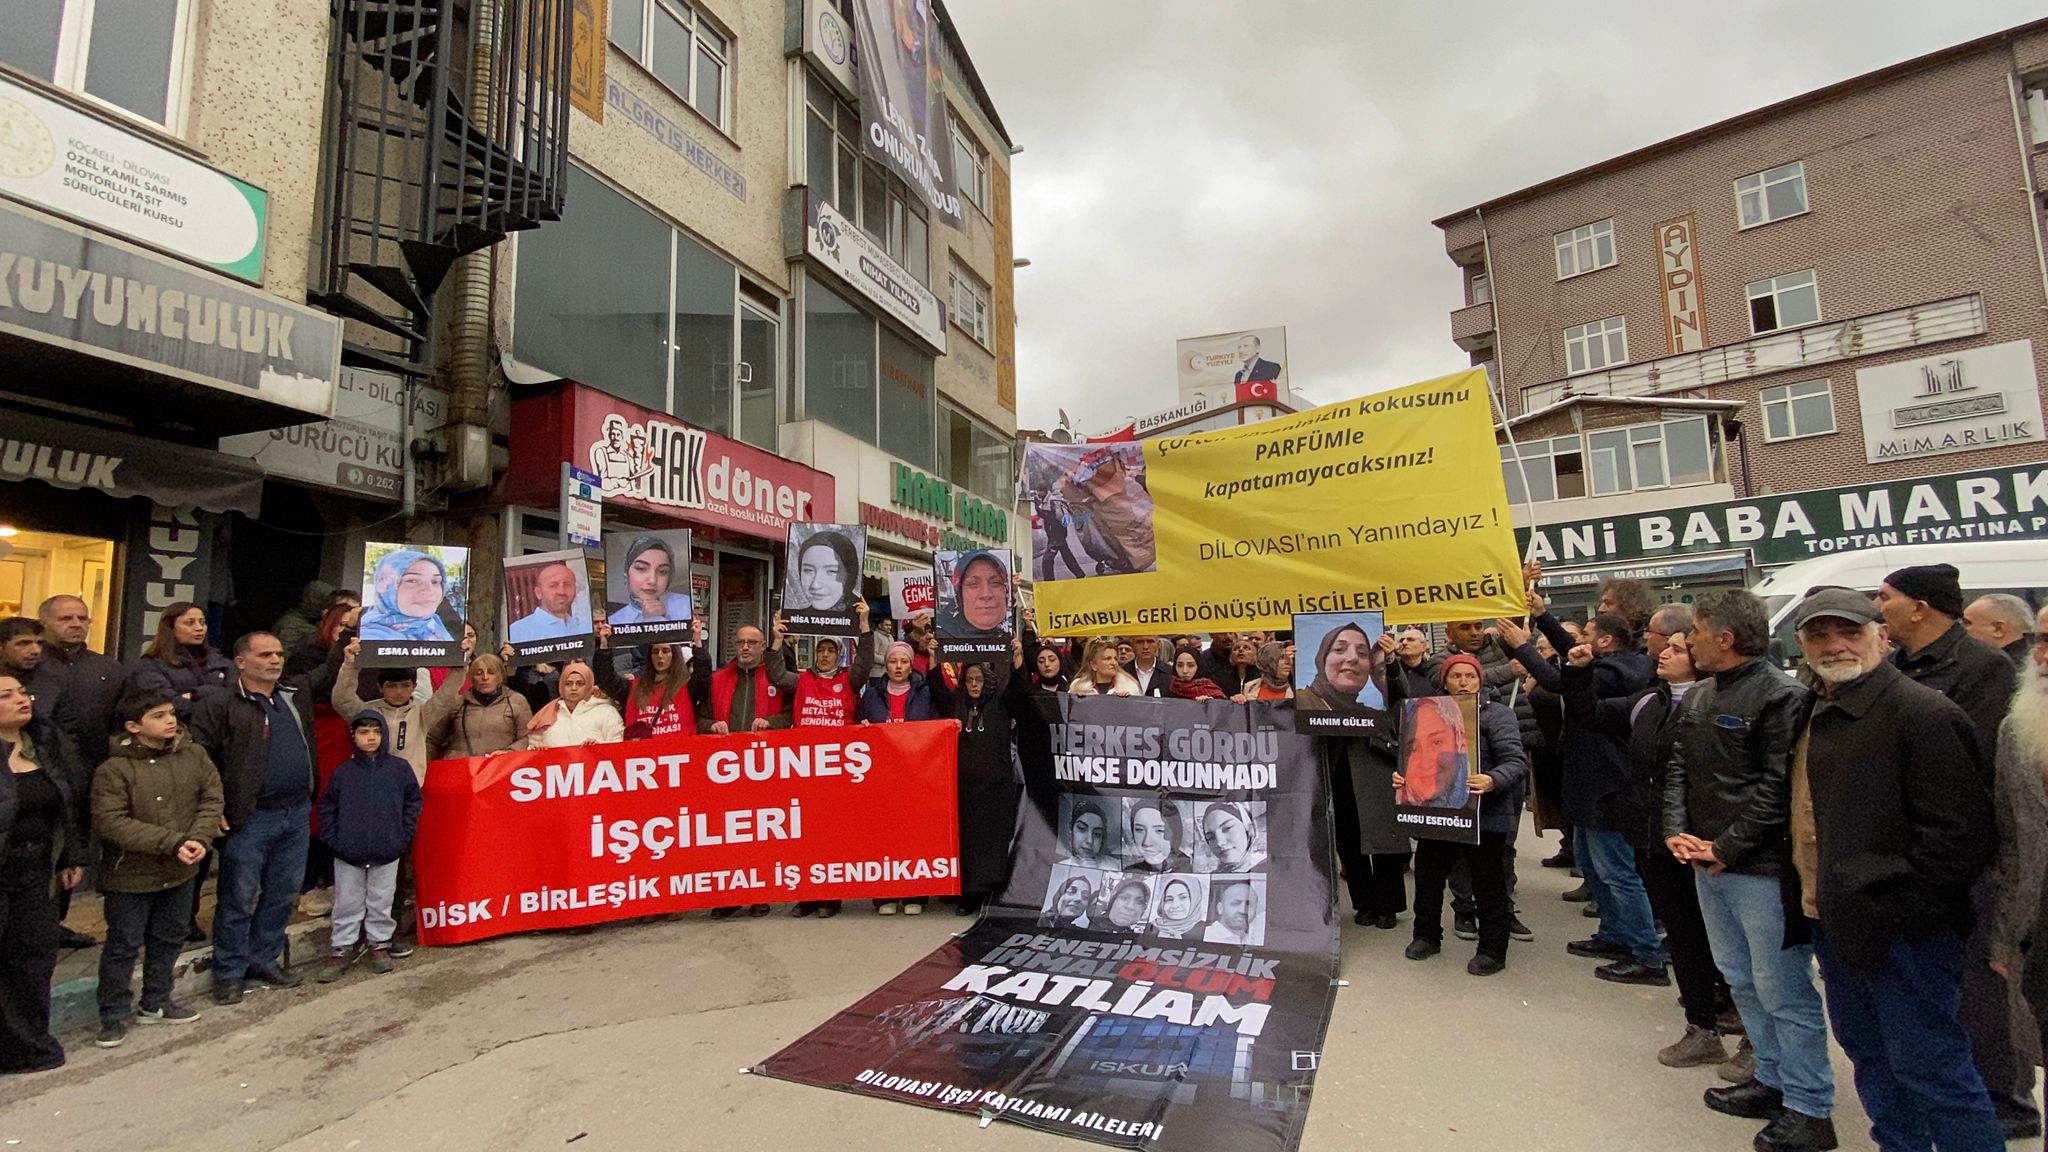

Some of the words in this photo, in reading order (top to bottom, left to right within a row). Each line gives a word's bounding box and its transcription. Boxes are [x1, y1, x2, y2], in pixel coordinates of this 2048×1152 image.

[609, 83, 665, 140] ALGAÇ
[65, 163, 127, 194] MOTORLU
[130, 188, 163, 208] TAŞIT
[66, 150, 99, 171] ÖZEL
[102, 164, 141, 187] KAMİL
[144, 181, 188, 206] SARMIŞ
[870, 122, 961, 220] ONURUMDUR
[63, 177, 141, 213] SÜRÜCÜLERİ
[143, 208, 183, 228] KURSU
[889, 280, 918, 312] YILMAZ
[1139, 400, 1207, 430] BAŞKANLIĞI
[1359, 387, 1470, 416] kokusunu
[0, 437, 123, 489] ULUK
[1255, 428, 1365, 462] PARFÜMle
[651, 425, 704, 505] HAK
[1204, 447, 1434, 500] kapatamayacaksınız!
[707, 456, 812, 522] döner
[730, 507, 756, 522] soslu
[757, 513, 786, 529] HATAY
[956, 491, 1008, 543] BABA
[1638, 499, 1809, 551] BABA
[1839, 469, 2048, 531] MARK
[1347, 511, 1485, 548] Yanındayız
[1804, 531, 1898, 553] TOPTAN
[863, 559, 882, 572] ABA
[1563, 573, 1600, 584] BABA
[1614, 566, 1674, 580] MARKET
[790, 613, 811, 625] NİSA
[812, 615, 851, 627] TAŞDEMİR
[1049, 610, 1131, 630] İSTANBUL
[1137, 603, 1178, 624] GERİ
[1184, 599, 1292, 623] DÖNÜŞÜM
[1397, 573, 1506, 606] DERNEĞİ
[613, 623, 641, 636] TUĞBA
[643, 621, 688, 634] TAŞDEMİR
[378, 647, 410, 657] ESMA
[411, 645, 446, 657] GİKAN
[520, 645, 554, 657] TUNCAY
[555, 640, 584, 651] YILDIZ
[943, 642, 974, 654] ŞENGÜL
[975, 643, 1006, 653] YILMAZ
[800, 716, 845, 727] SENDİKASI
[802, 707, 825, 716] METAL
[1309, 717, 1341, 726] HANIM
[1342, 716, 1375, 728] GÜLEK
[1050, 723, 1160, 759] HERKES
[1168, 724, 1279, 764] GÖRDÜ
[509, 754, 690, 803] SMART
[706, 741, 873, 784] GÜNEŞ
[1054, 752, 1120, 783] KİMSE
[1126, 759, 1278, 790] DOKUNMADI
[590, 798, 802, 864] İŞÇİLERİ
[1397, 813, 1424, 824] CANSU
[1426, 815, 1472, 829] ESETOĞLU
[421, 898, 492, 930] DİSK
[520, 876, 660, 915] BİRLEŞİK
[669, 869, 766, 897] METAL
[774, 861, 801, 890] İŞ
[809, 855, 958, 885] SENDİKASI
[980, 946, 1123, 979] İHMAL
[1000, 932, 1281, 980] DENETİMSİZLİK
[942, 964, 1272, 1037] KATLİAM
